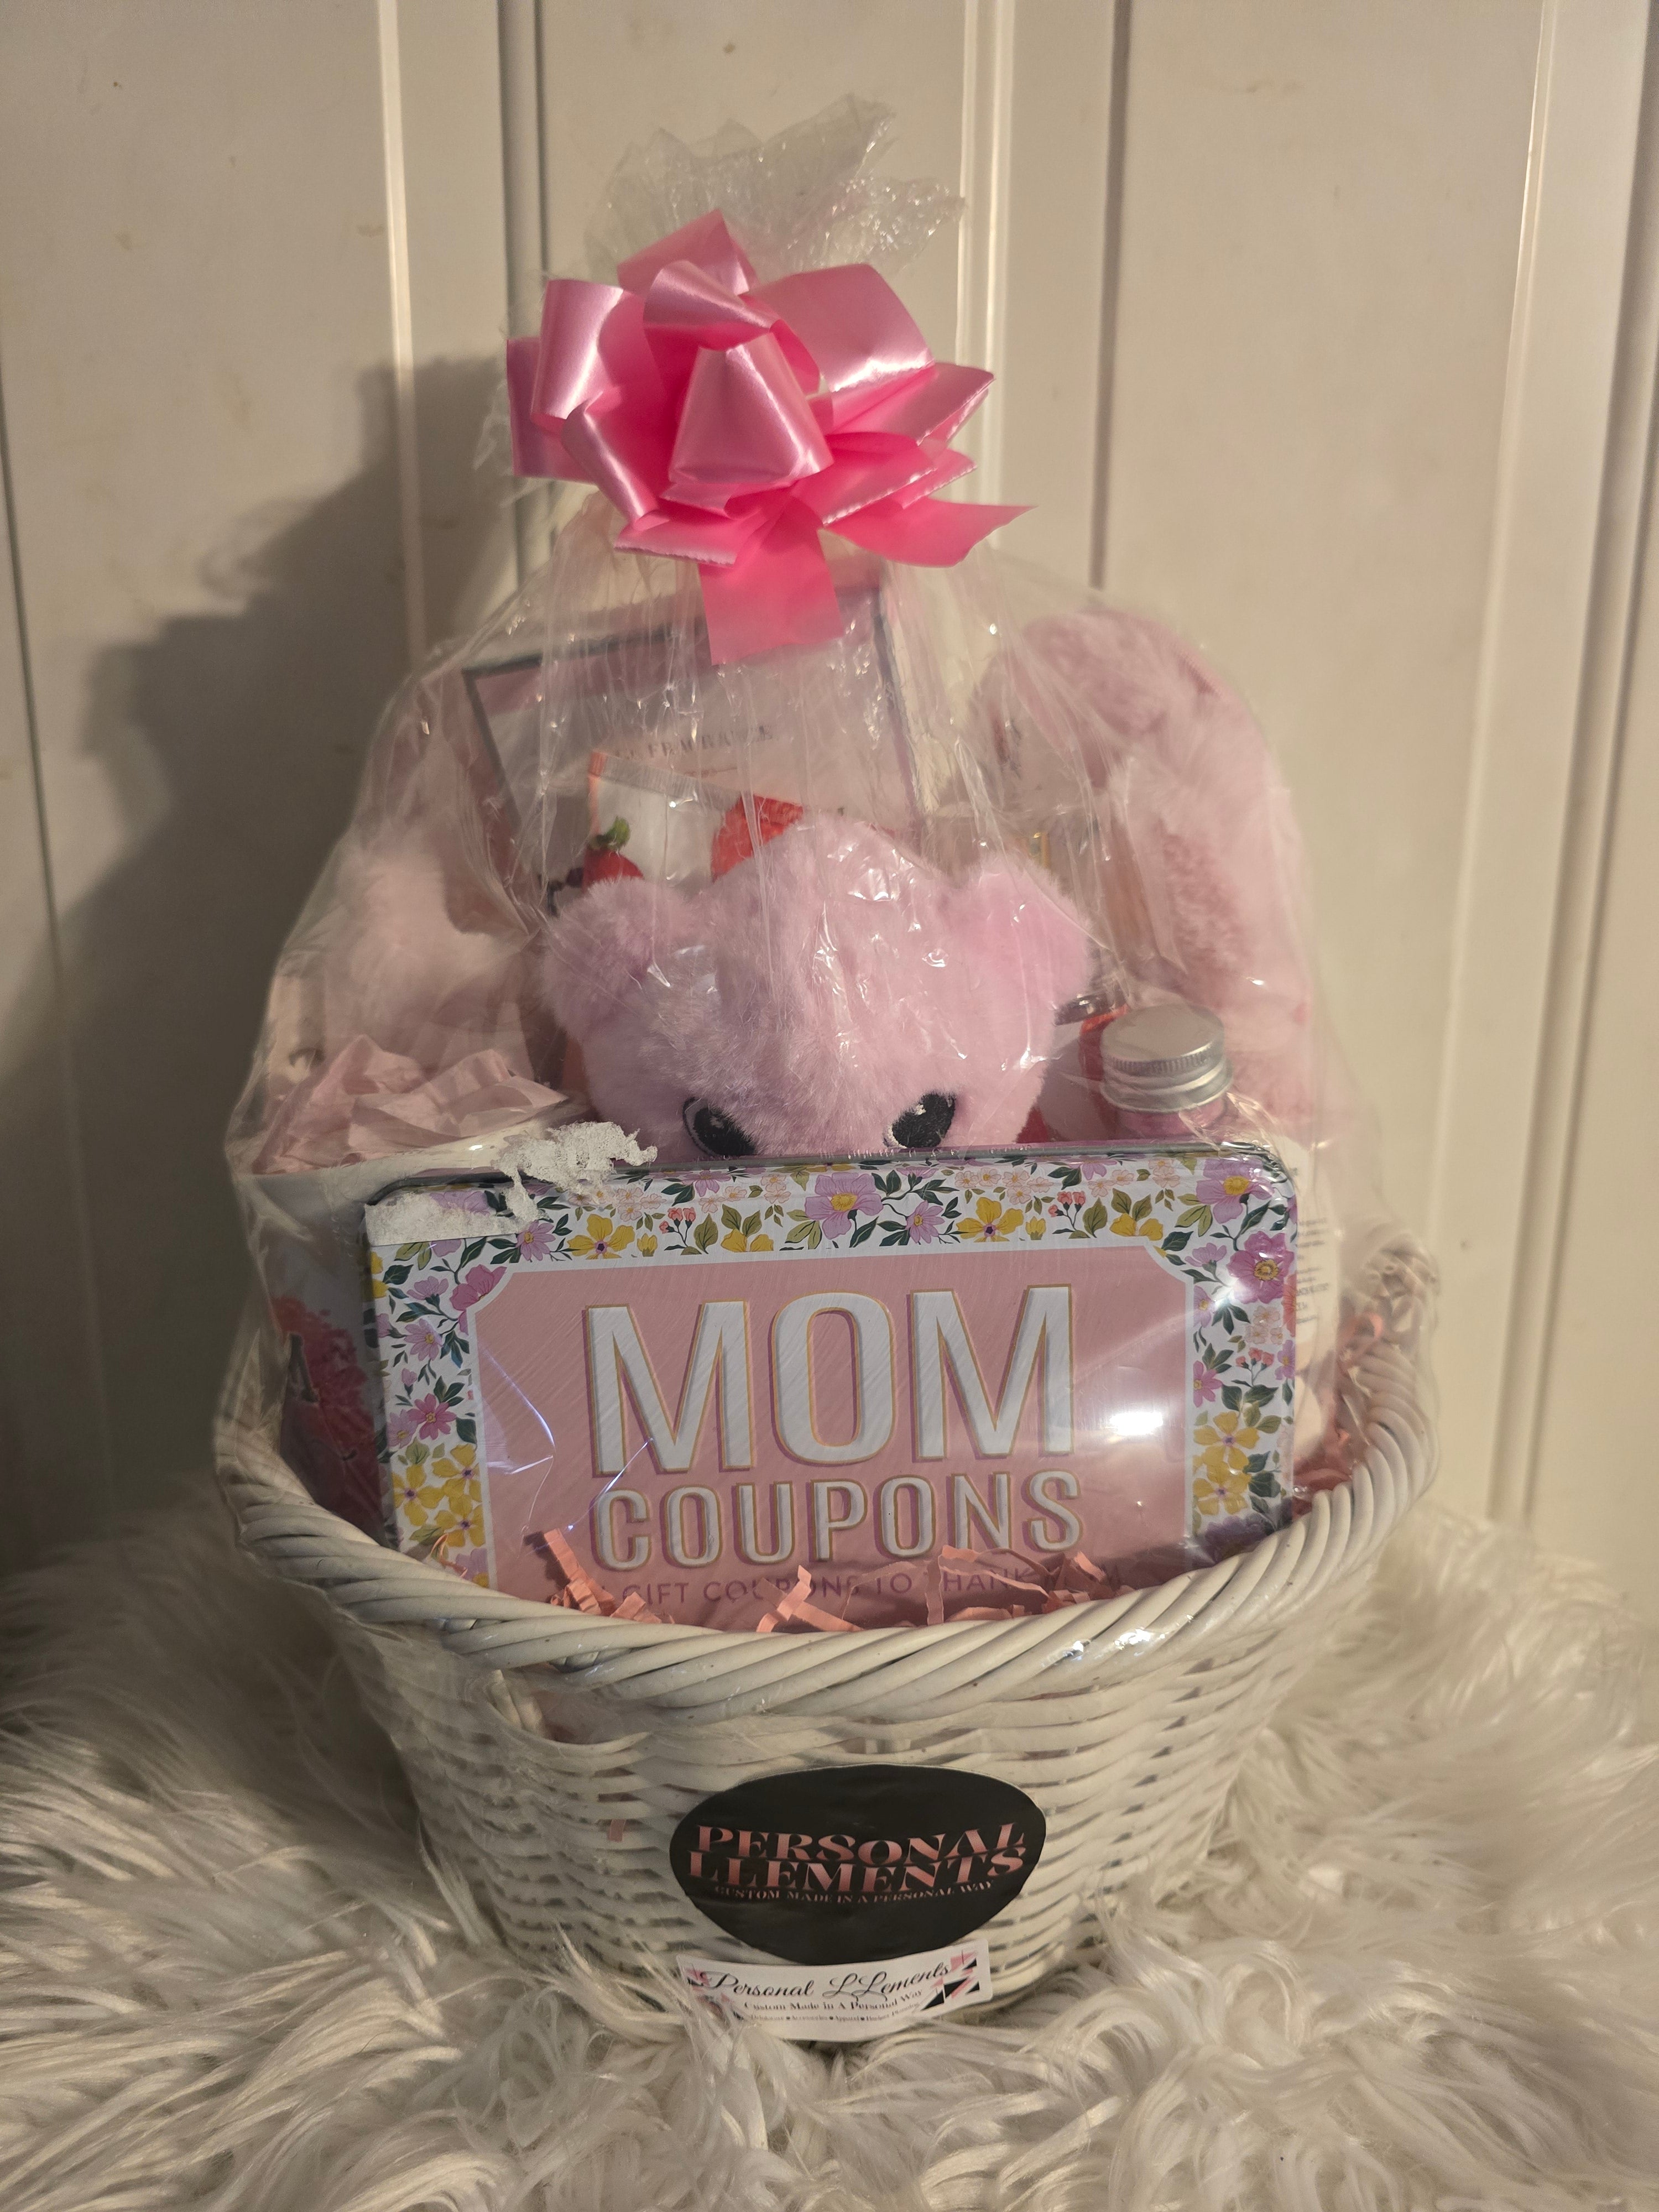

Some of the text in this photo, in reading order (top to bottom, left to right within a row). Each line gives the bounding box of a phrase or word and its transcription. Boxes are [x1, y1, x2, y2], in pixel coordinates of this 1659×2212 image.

[582, 1284, 1074, 1477] MOM
[590, 1470, 1081, 1571] COUPONS
[924, 1567, 1036, 1593] HANK
[697, 1822, 1026, 1866] PERSONAL
[686, 1846, 1027, 1893] LLEMENTS
[715, 1880, 994, 1903] CUSTOM MADE IN A PERSONAL WAY
[700, 1970, 815, 1997] Personal
[790, 2001, 820, 2010] Made
[838, 2001, 846, 2010] A
